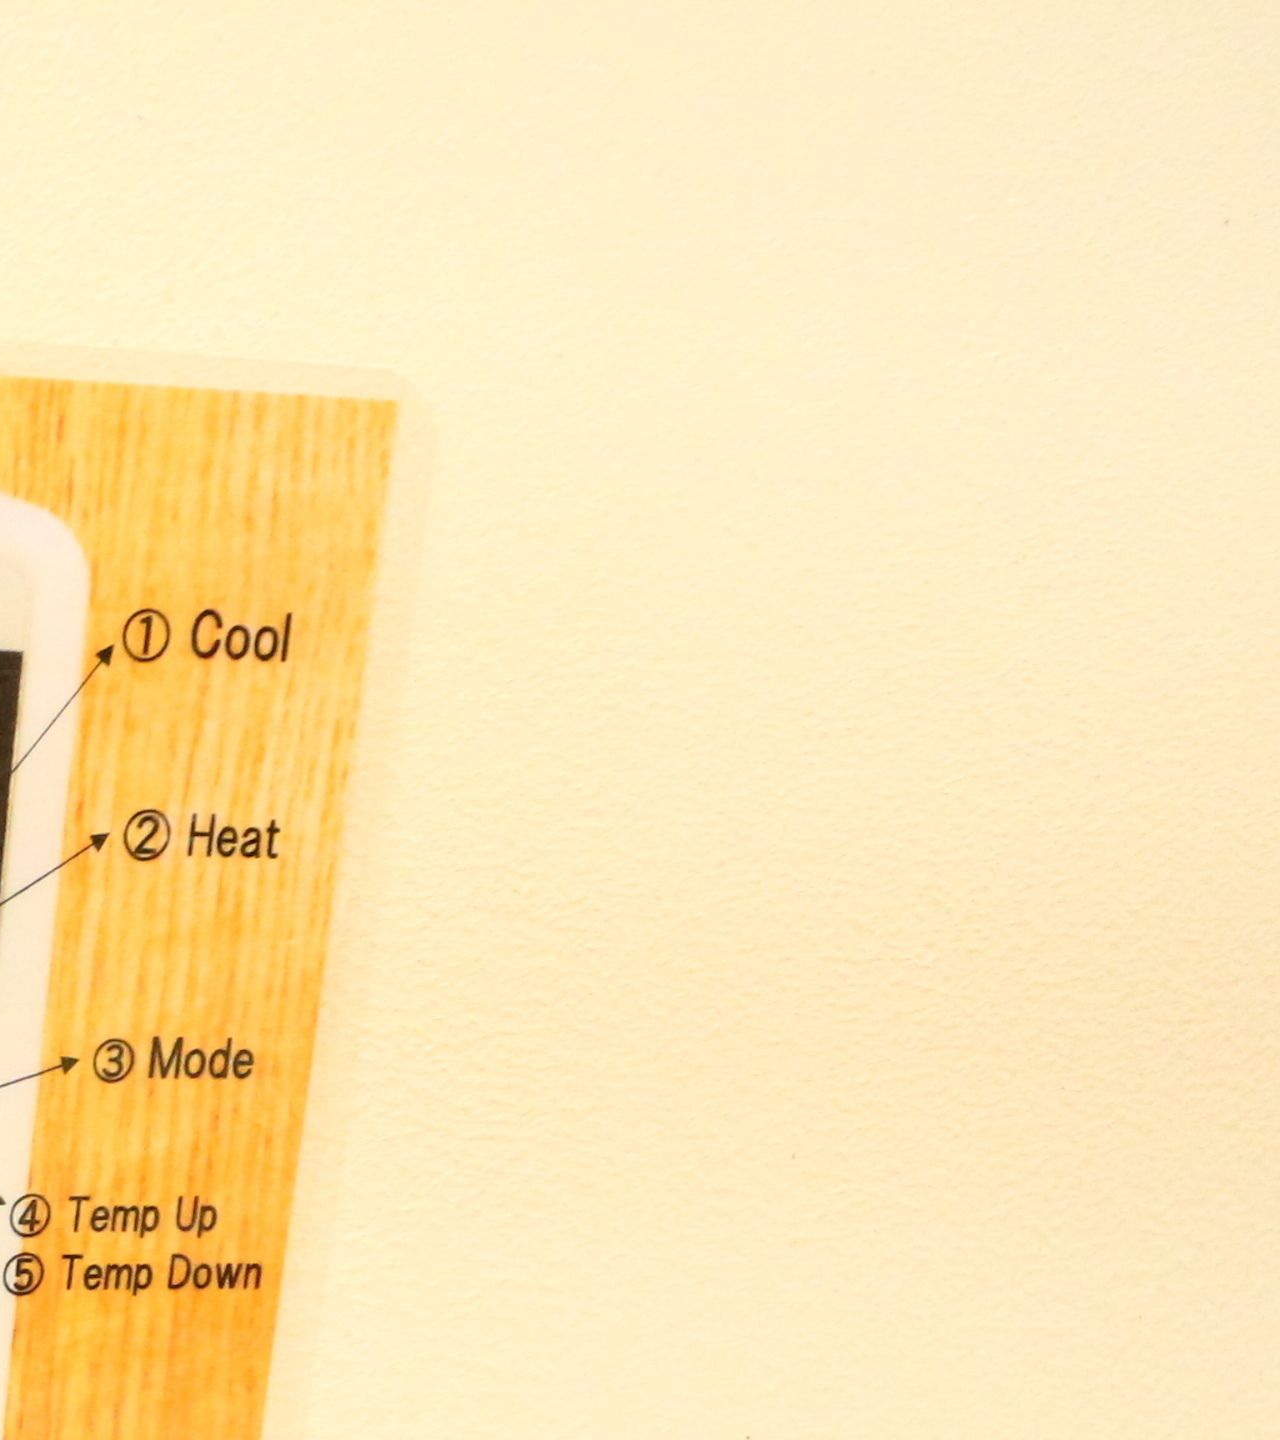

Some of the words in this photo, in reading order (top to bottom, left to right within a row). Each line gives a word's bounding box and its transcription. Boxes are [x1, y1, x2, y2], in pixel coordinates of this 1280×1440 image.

[191, 609, 293, 662] Cool
[186, 813, 281, 860] Heat
[148, 1037, 255, 1080] Mode
[68, 1196, 159, 1236] Temp
[175, 1197, 218, 1237] Up
[61, 1254, 153, 1295] Temp
[167, 1254, 263, 1290] Down
